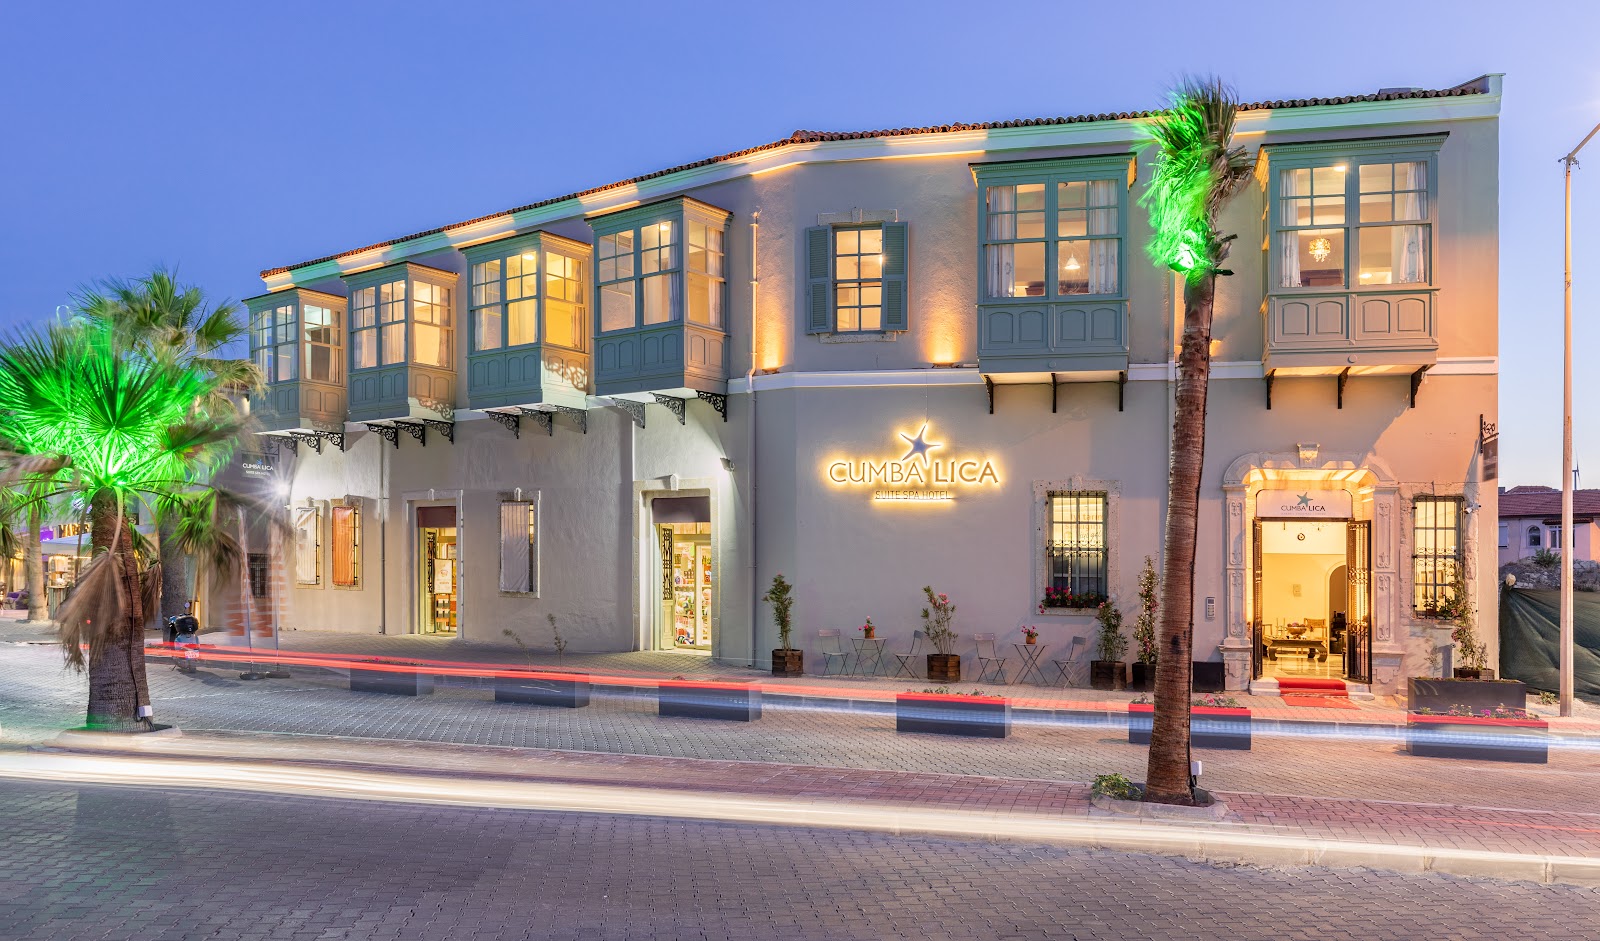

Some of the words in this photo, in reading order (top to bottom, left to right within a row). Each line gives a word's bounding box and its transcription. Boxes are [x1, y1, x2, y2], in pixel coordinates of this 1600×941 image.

[829, 462, 924, 483] CUMBA
[934, 461, 999, 484] LICA
[875, 490, 901, 500] SUITE
[903, 490, 920, 500] SPA
[923, 490, 951, 500] HOTEL
